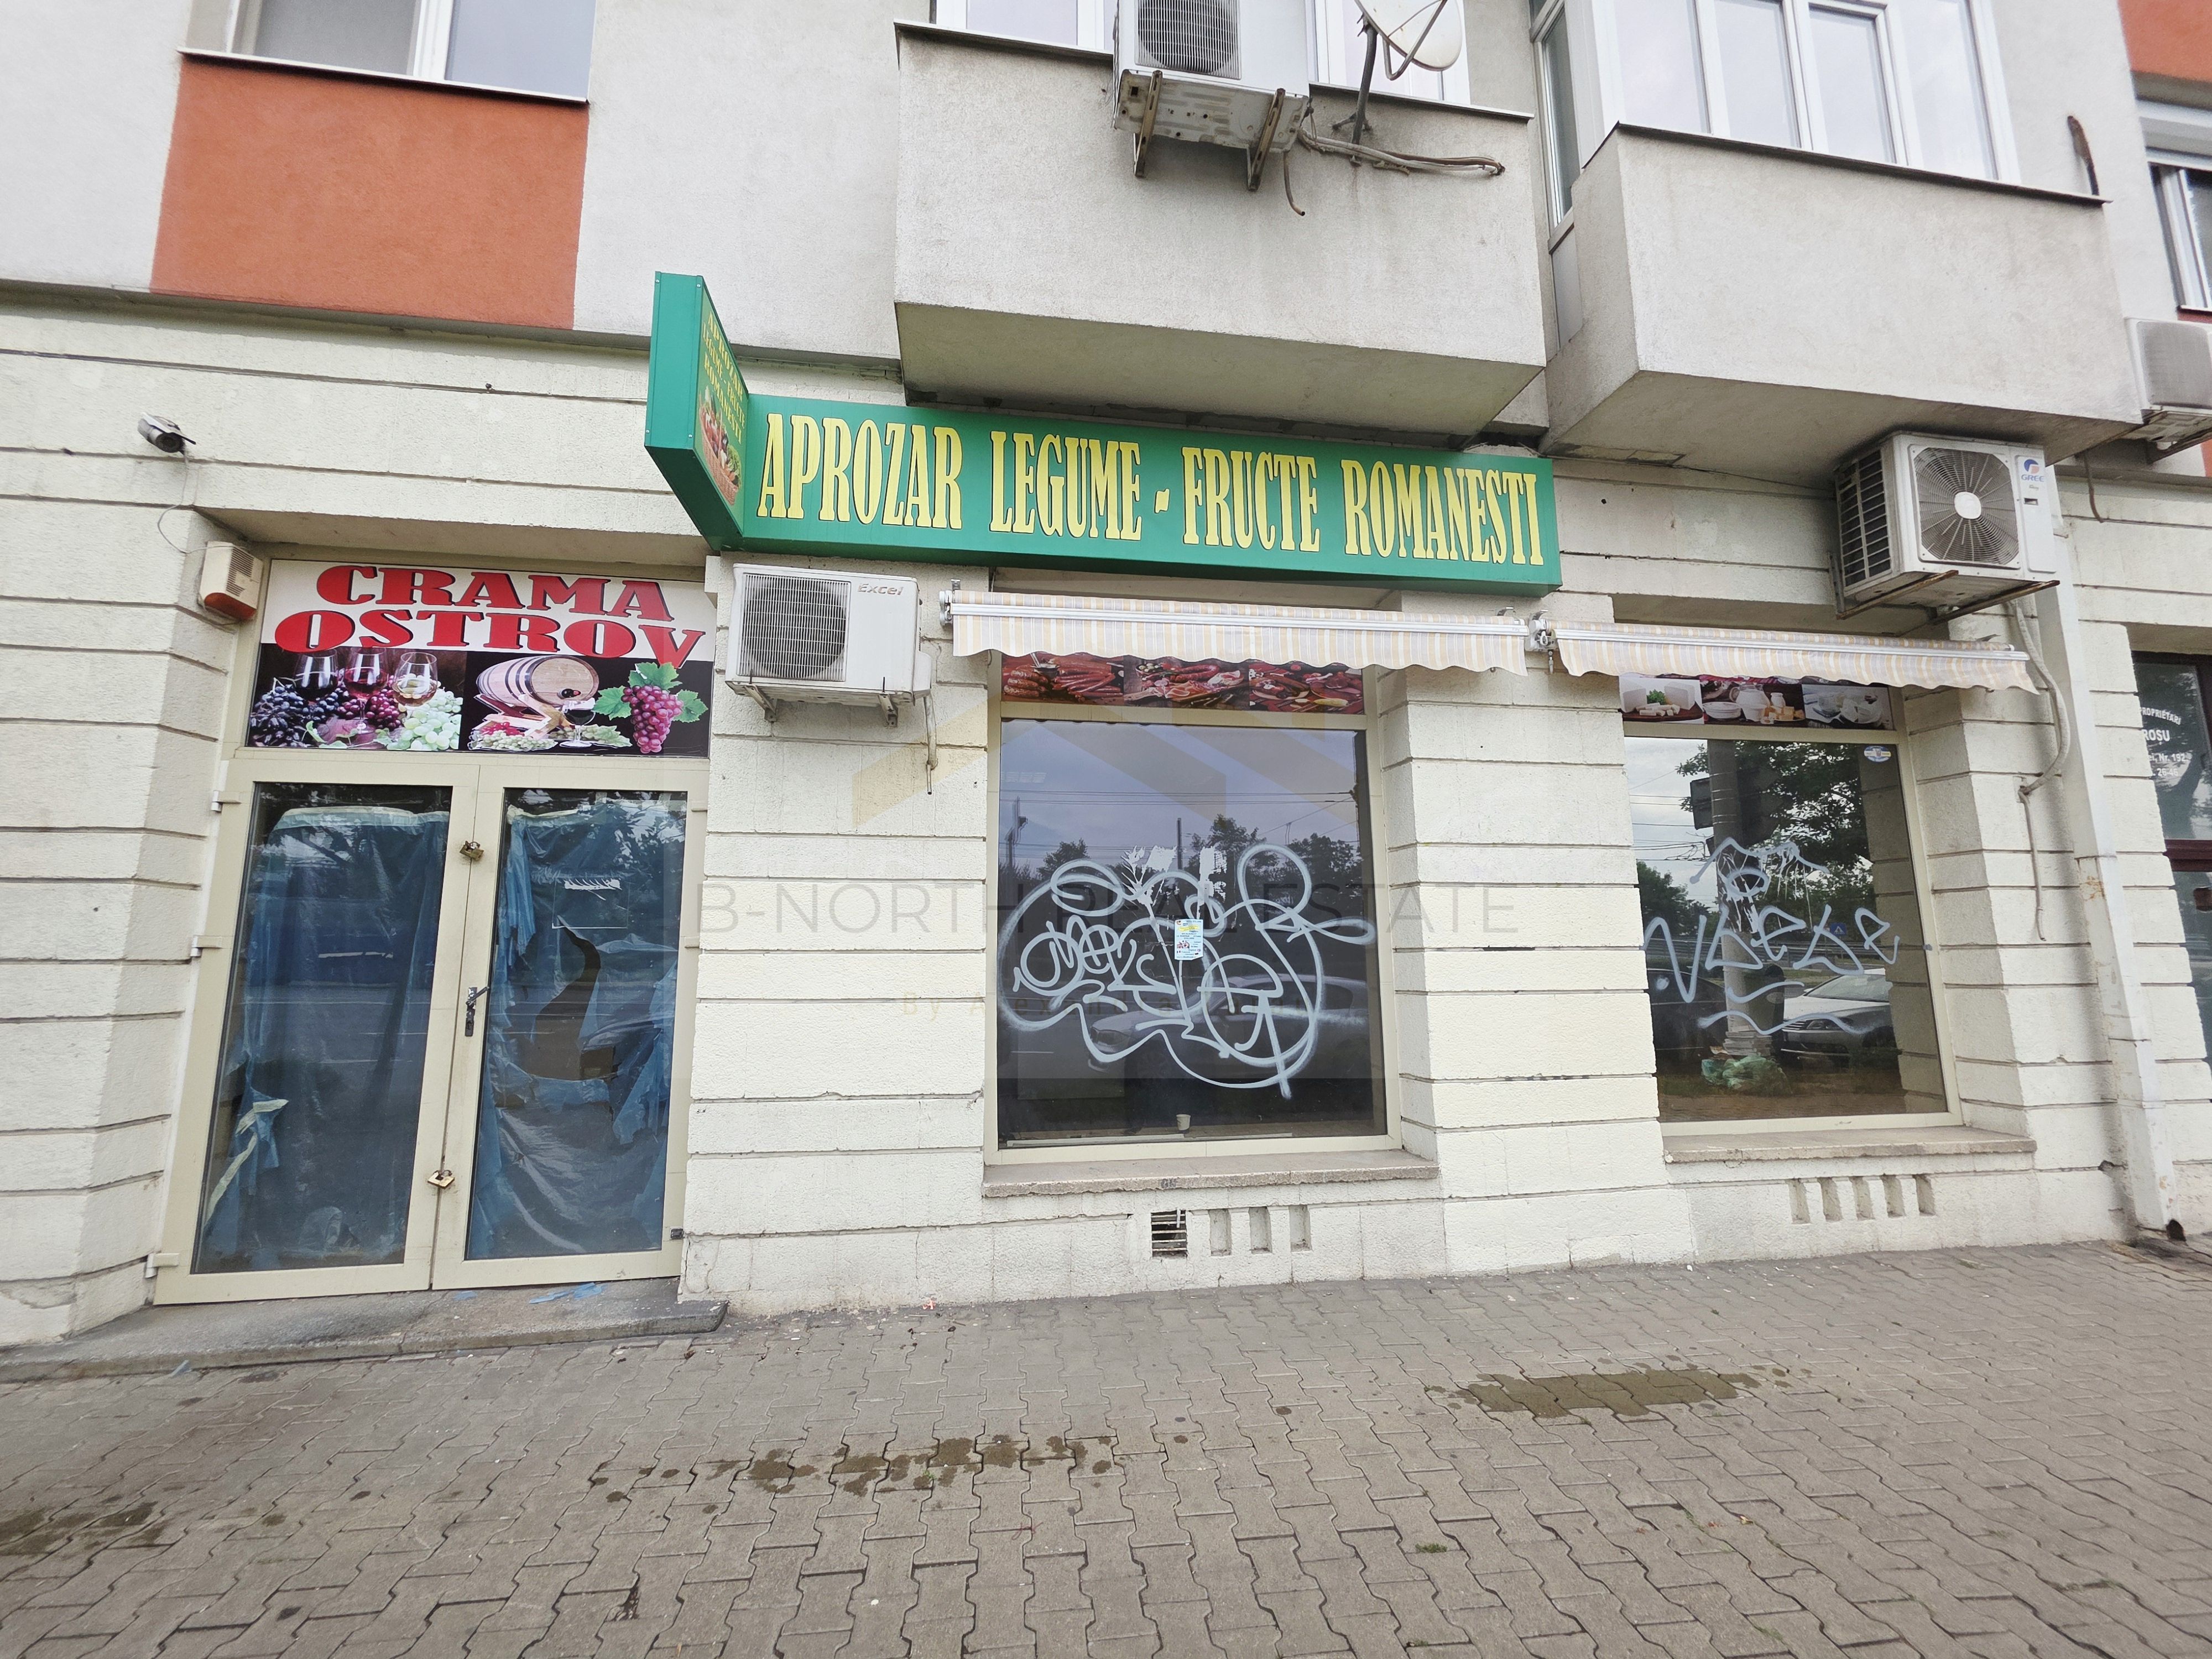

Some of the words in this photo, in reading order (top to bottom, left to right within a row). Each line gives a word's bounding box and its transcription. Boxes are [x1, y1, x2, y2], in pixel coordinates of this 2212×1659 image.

[702, 322, 722, 382] LEGUME
[708, 311, 743, 402] APROZAR
[704, 351, 742, 445] ROMANESTI
[758, 413, 963, 530] APROZAR
[989, 430, 1142, 541] LEGUME
[1154, 488, 1170, 513] -
[1181, 446, 1321, 552] FRUCTE
[1340, 459, 1545, 566] ROMANESTI
[2021, 474, 2044, 482] GREE
[316, 565, 676, 622] CRAMA
[858, 582, 904, 596] Excel
[274, 609, 706, 669] OSTROV
[2158, 753, 2171, 761] Nr.
